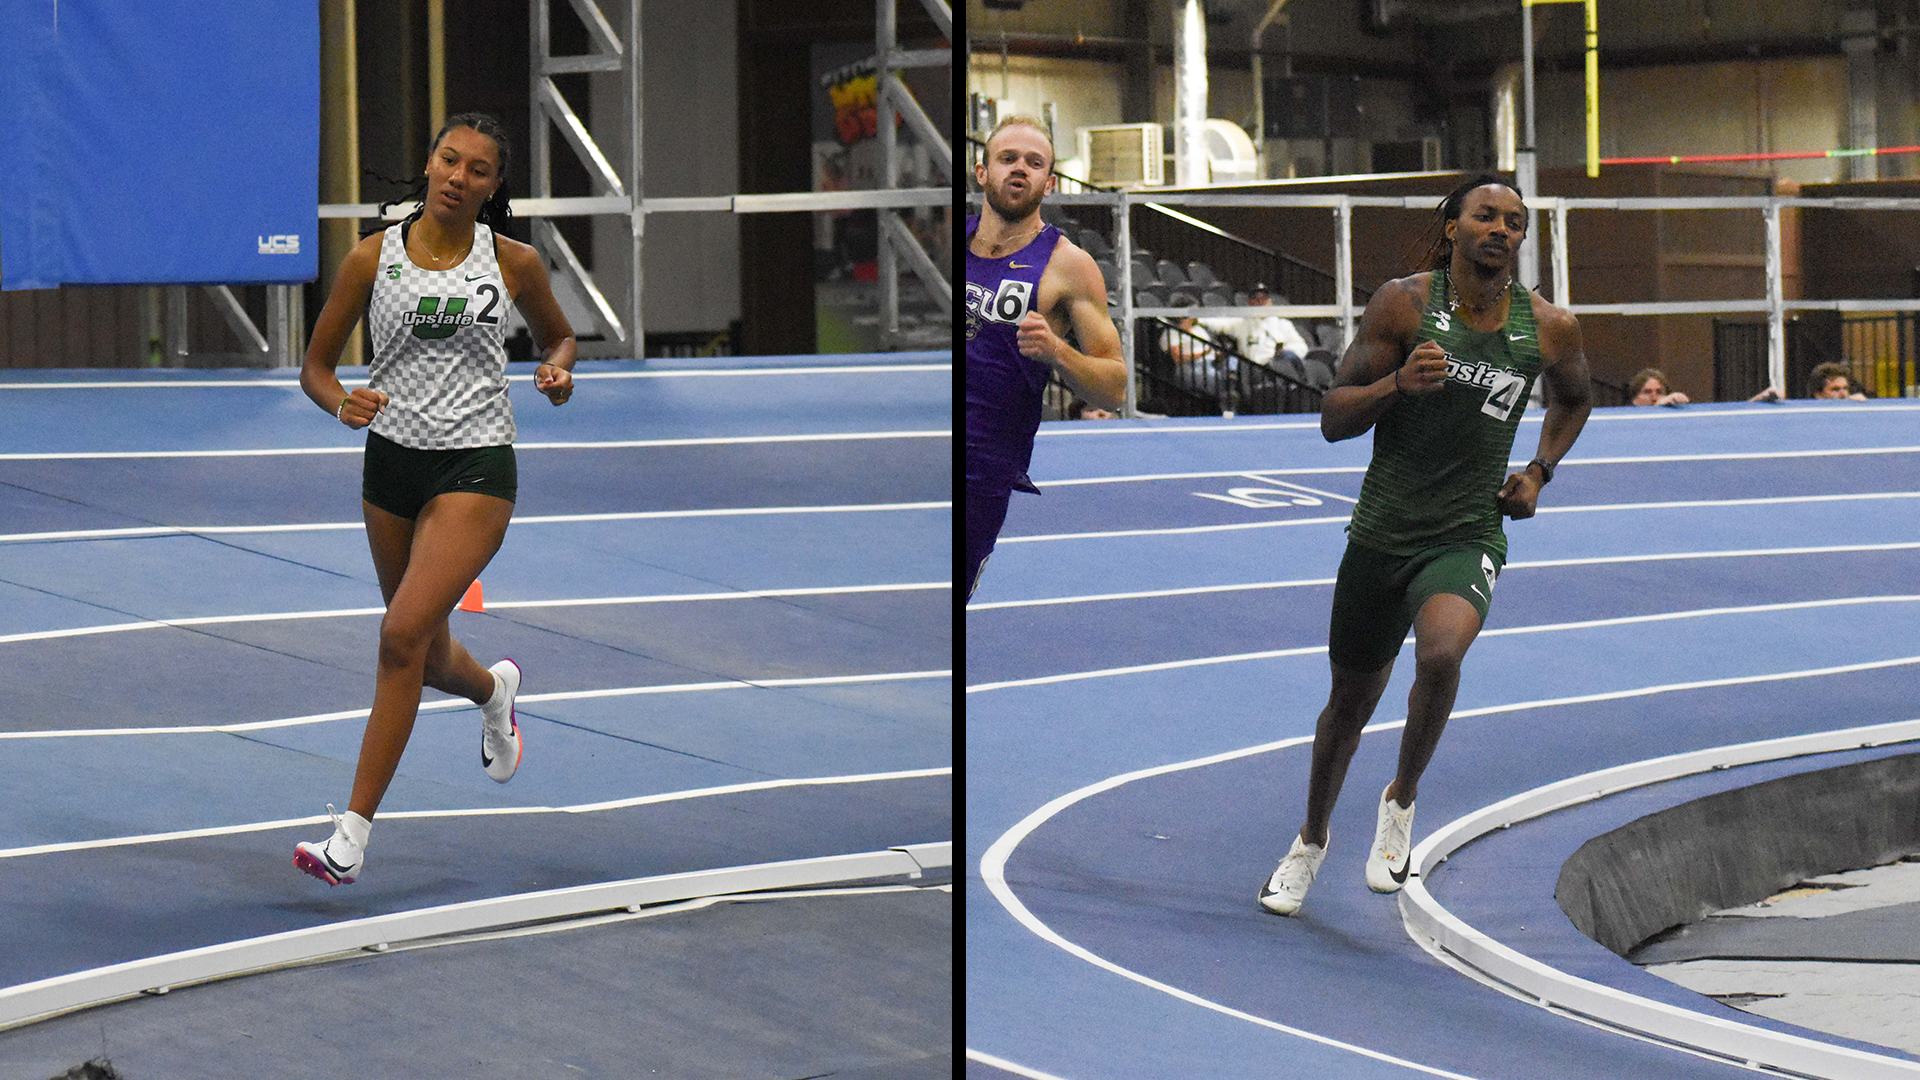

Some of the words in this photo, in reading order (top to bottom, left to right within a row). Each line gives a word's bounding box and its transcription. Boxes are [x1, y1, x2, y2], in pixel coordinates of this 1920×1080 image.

[258, 235, 299, 248] UCS
[476, 283, 500, 325] 2
[996, 282, 1025, 321] 6
[403, 311, 474, 329] Upstate
[1487, 380, 1519, 417] 4
[1192, 488, 1322, 508] 5
